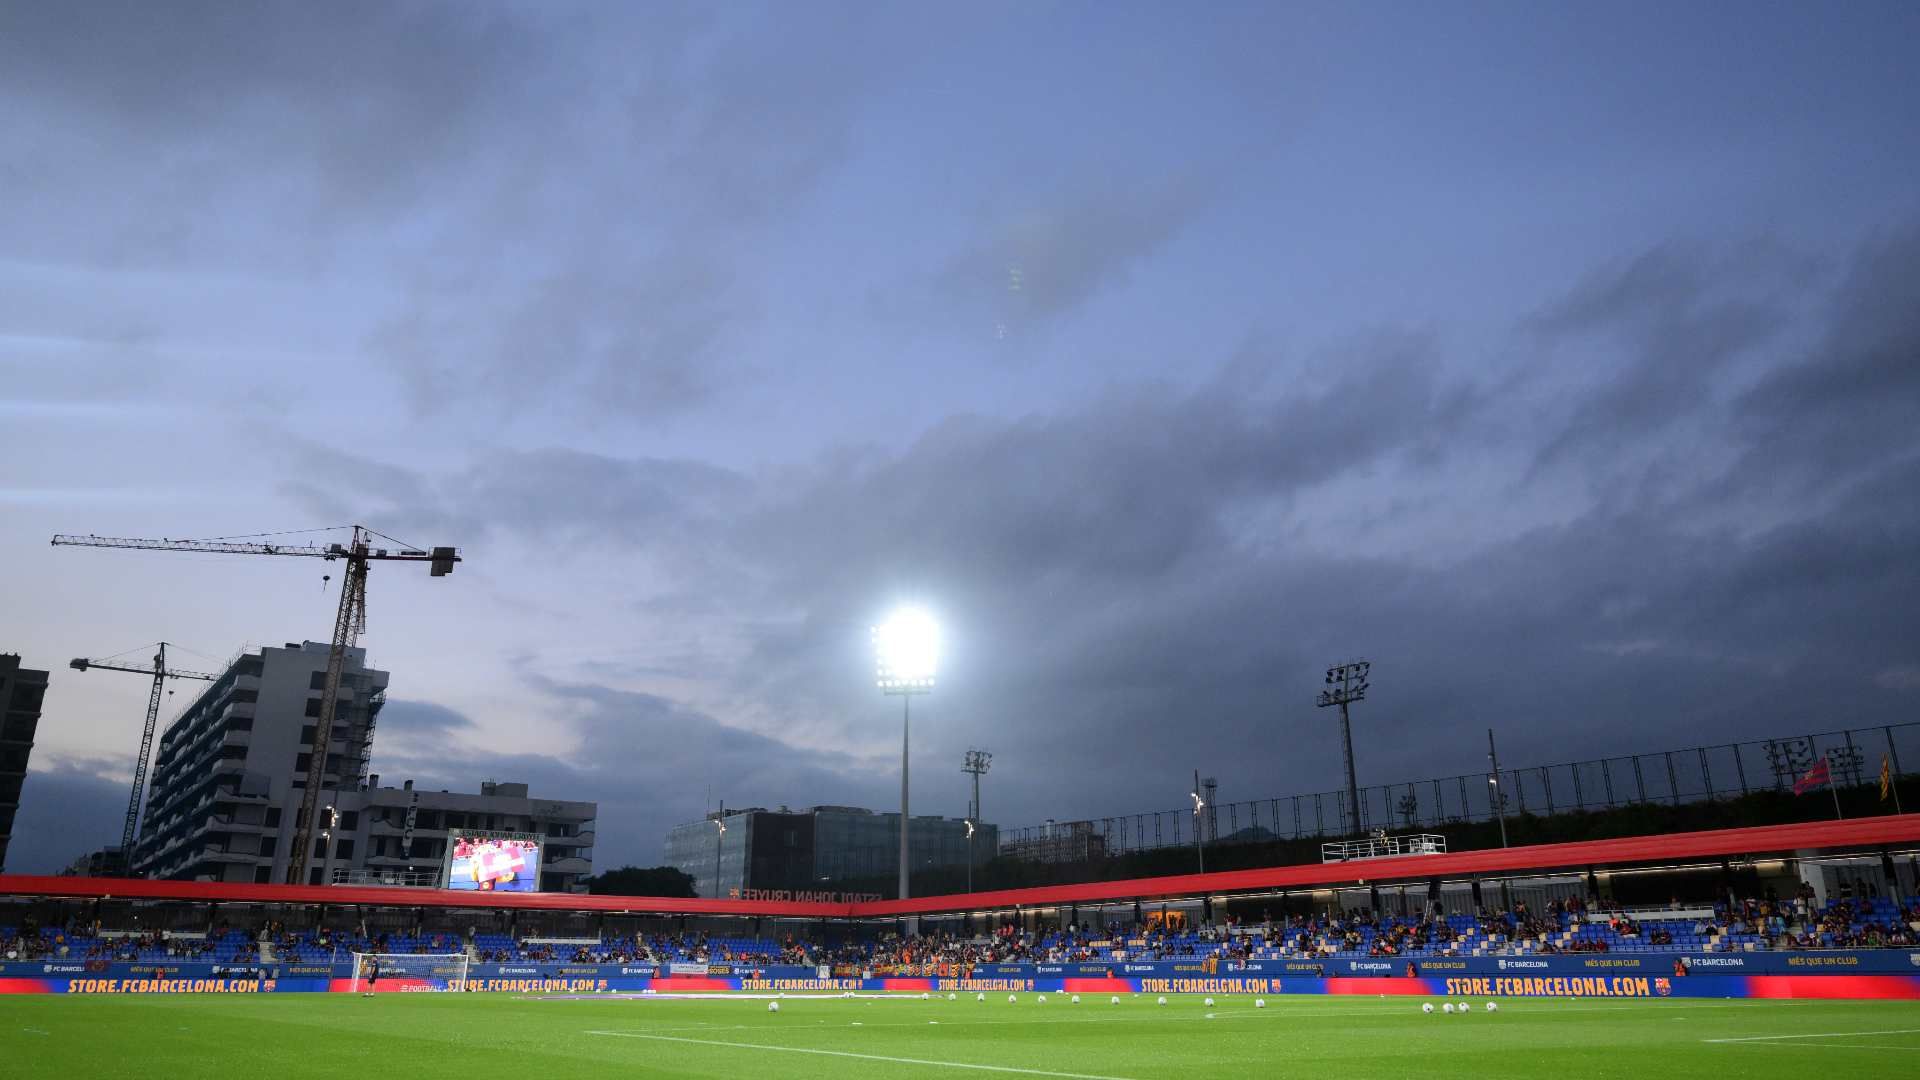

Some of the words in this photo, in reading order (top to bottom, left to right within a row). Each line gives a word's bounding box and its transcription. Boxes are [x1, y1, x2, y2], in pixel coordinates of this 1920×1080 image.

[1692, 958, 1701, 966] FC
[1702, 958, 1744, 966] BARCELONA
[1788, 956, 1805, 965] MÉS
[1807, 957, 1822, 965] QUE
[1823, 957, 1835, 965] UN
[1836, 957, 1857, 965] CLUB
[68, 979, 259, 993] STORE.FCBARCELONA.COM
[1141, 978, 1269, 993] STORE.FCBARCELONA.COM
[1446, 977, 1650, 996] STORE.FCBARCELONA.COM
